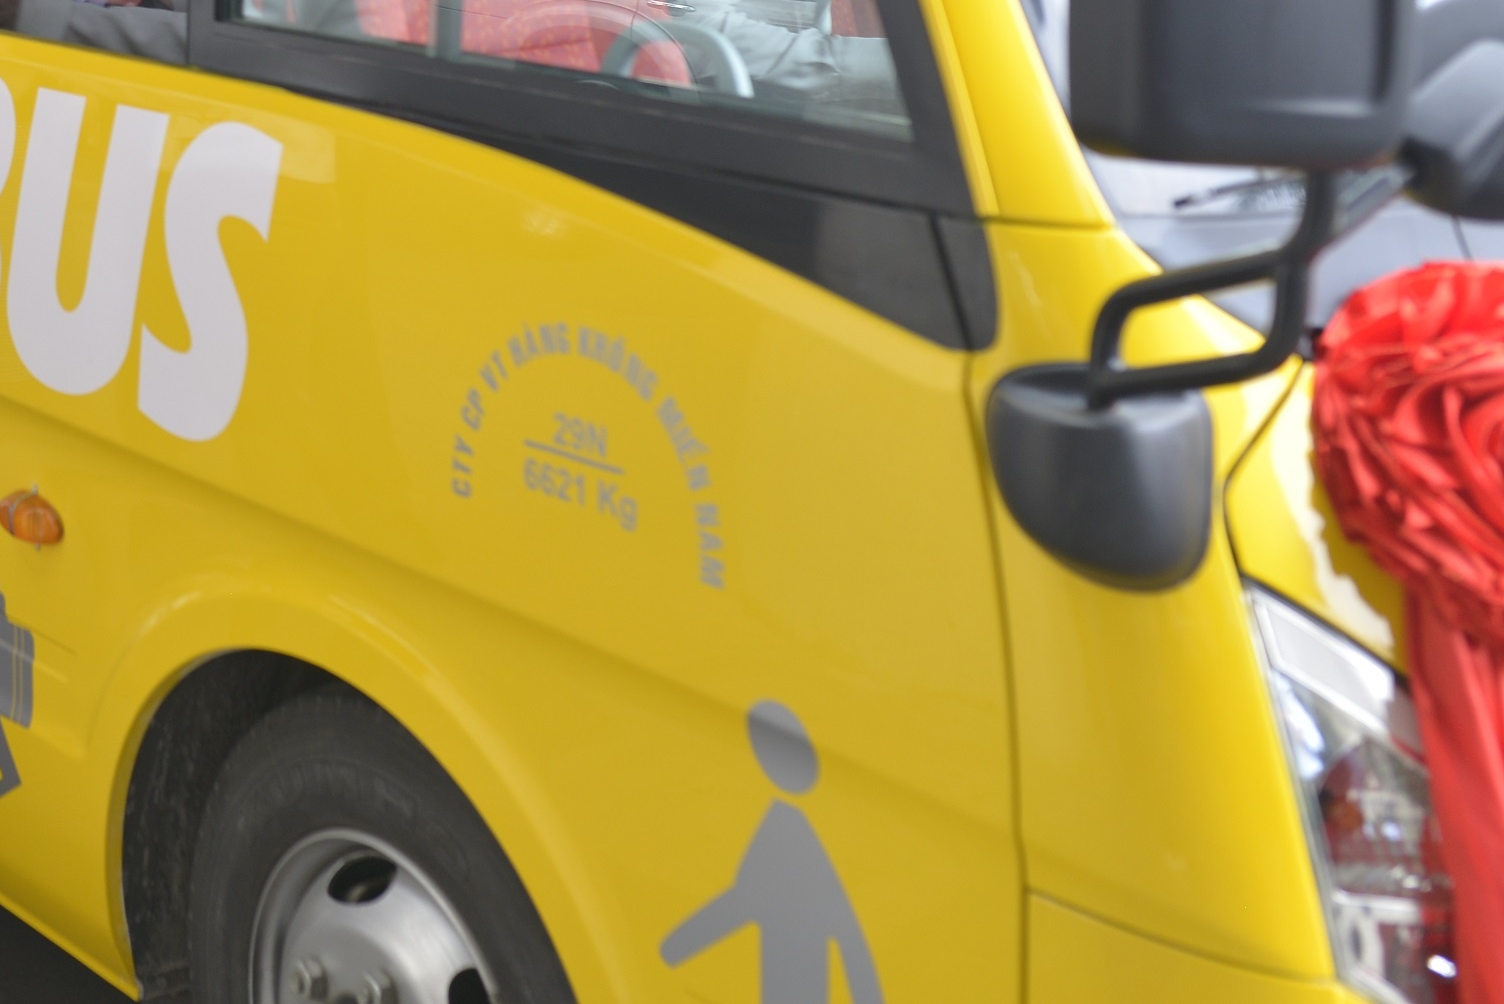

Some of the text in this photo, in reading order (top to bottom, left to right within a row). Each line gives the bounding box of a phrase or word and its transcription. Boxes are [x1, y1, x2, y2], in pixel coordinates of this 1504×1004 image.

[479, 350, 509, 392] VT
[461, 387, 486, 431] CP
[551, 412, 609, 459] 29N
[451, 434, 475, 498] CTY
[523, 458, 638, 533] 6621 Kg
[694, 502, 727, 590] NAM
